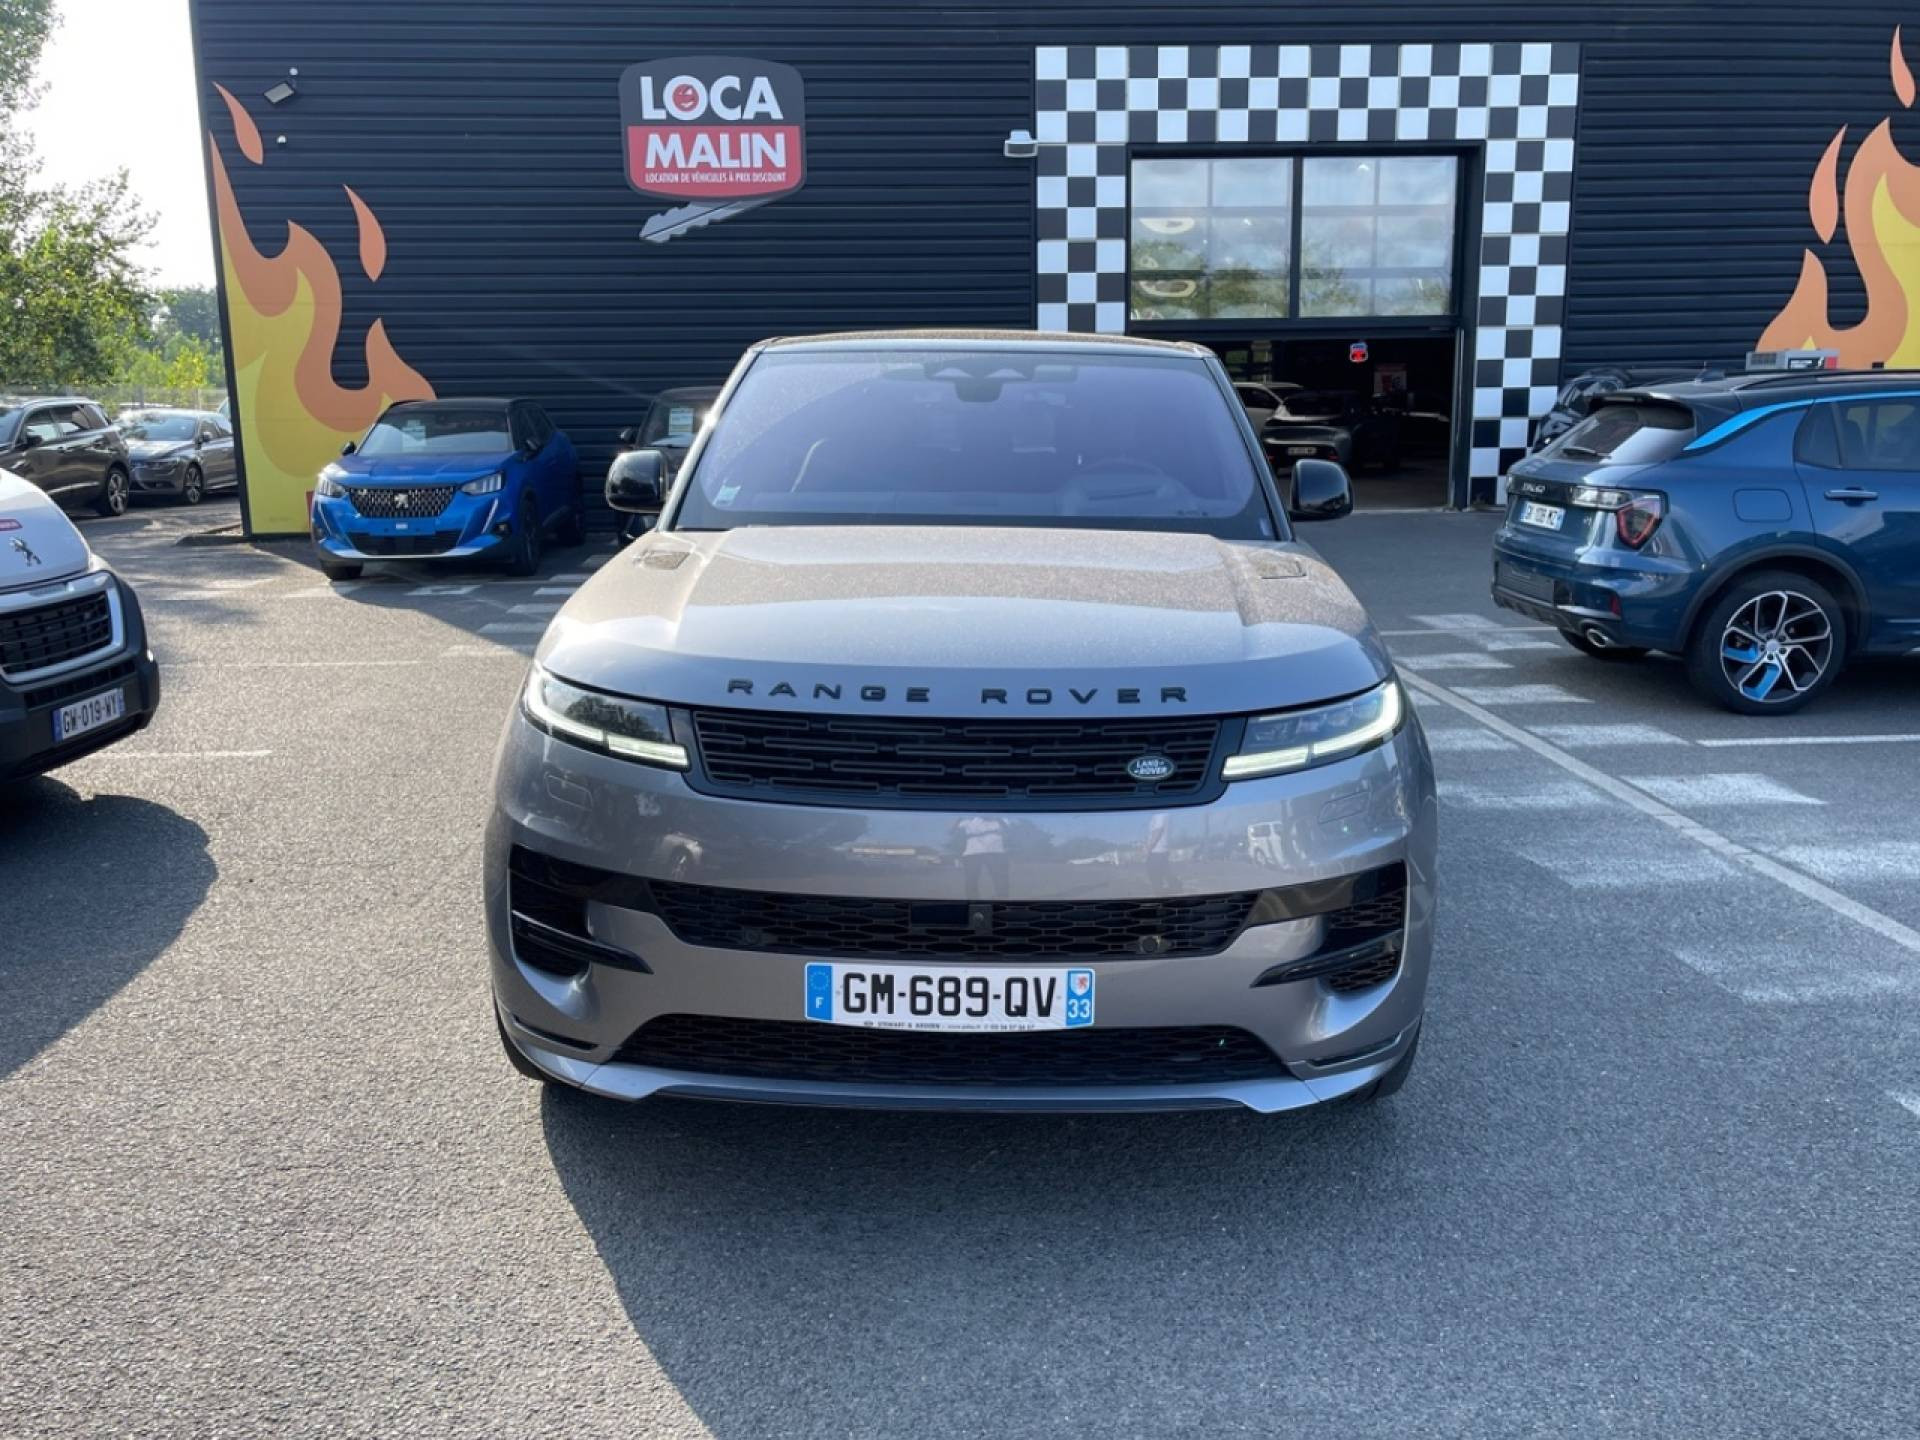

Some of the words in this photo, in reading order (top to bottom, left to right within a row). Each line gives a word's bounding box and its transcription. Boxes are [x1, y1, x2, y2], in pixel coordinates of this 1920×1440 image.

[639, 75, 784, 121] LOCA
[645, 133, 787, 168] MALIN
[645, 172, 679, 183] LOCATION
[681, 172, 690, 183] DE
[692, 170, 726, 183] VÉHICULES
[736, 172, 750, 182] PRIX
[752, 172, 786, 183] DISCOUNT
[727, 678, 930, 703] RANGE
[981, 687, 1188, 705] ROVER
[815, 997, 823, 1009] F
[842, 972, 1057, 1018] GM-689-QV
[1067, 998, 1091, 1020] 33
